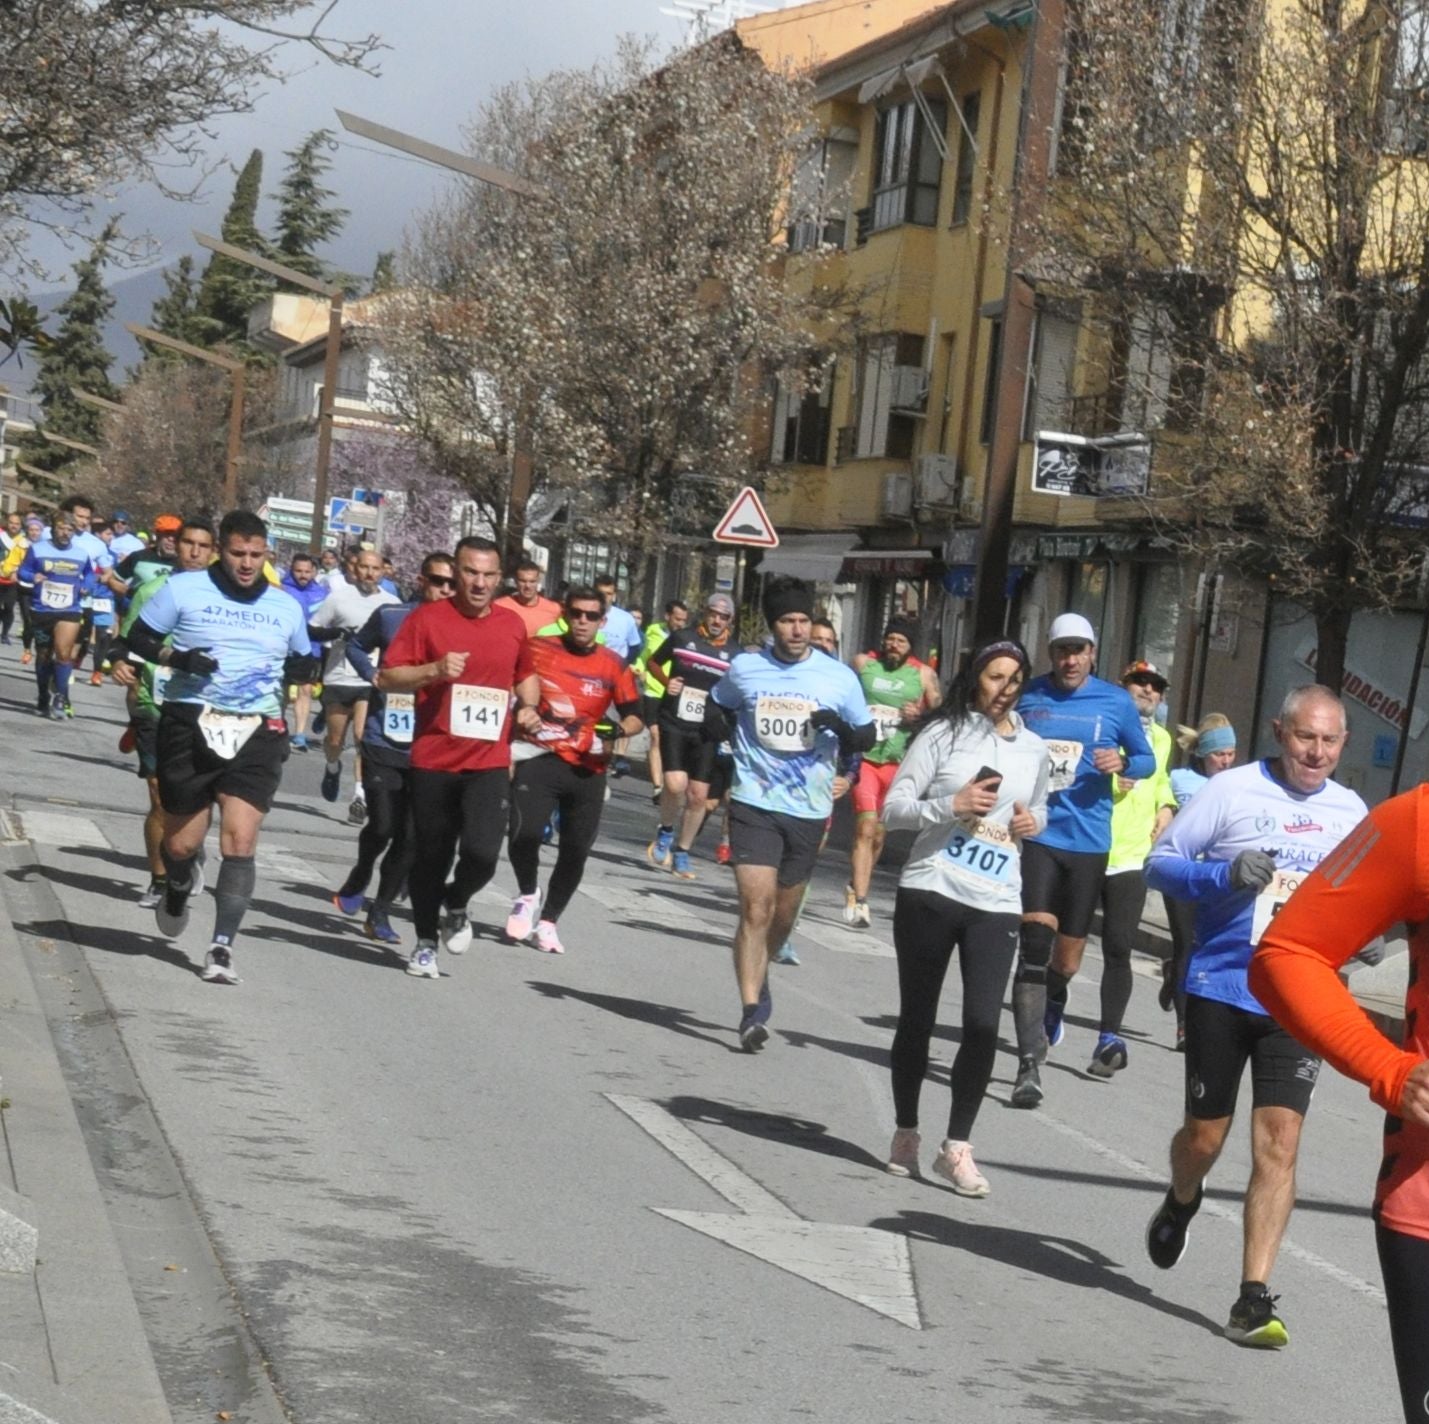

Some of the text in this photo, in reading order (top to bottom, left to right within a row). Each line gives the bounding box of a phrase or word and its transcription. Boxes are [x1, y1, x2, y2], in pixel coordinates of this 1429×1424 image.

[225, 608, 282, 629] MEDIA
[388, 713, 411, 730] 31
[462, 705, 499, 726] 141
[760, 718, 809, 738] 3001
[976, 823, 1008, 842] ONDO
[947, 835, 1010, 876] 3107
